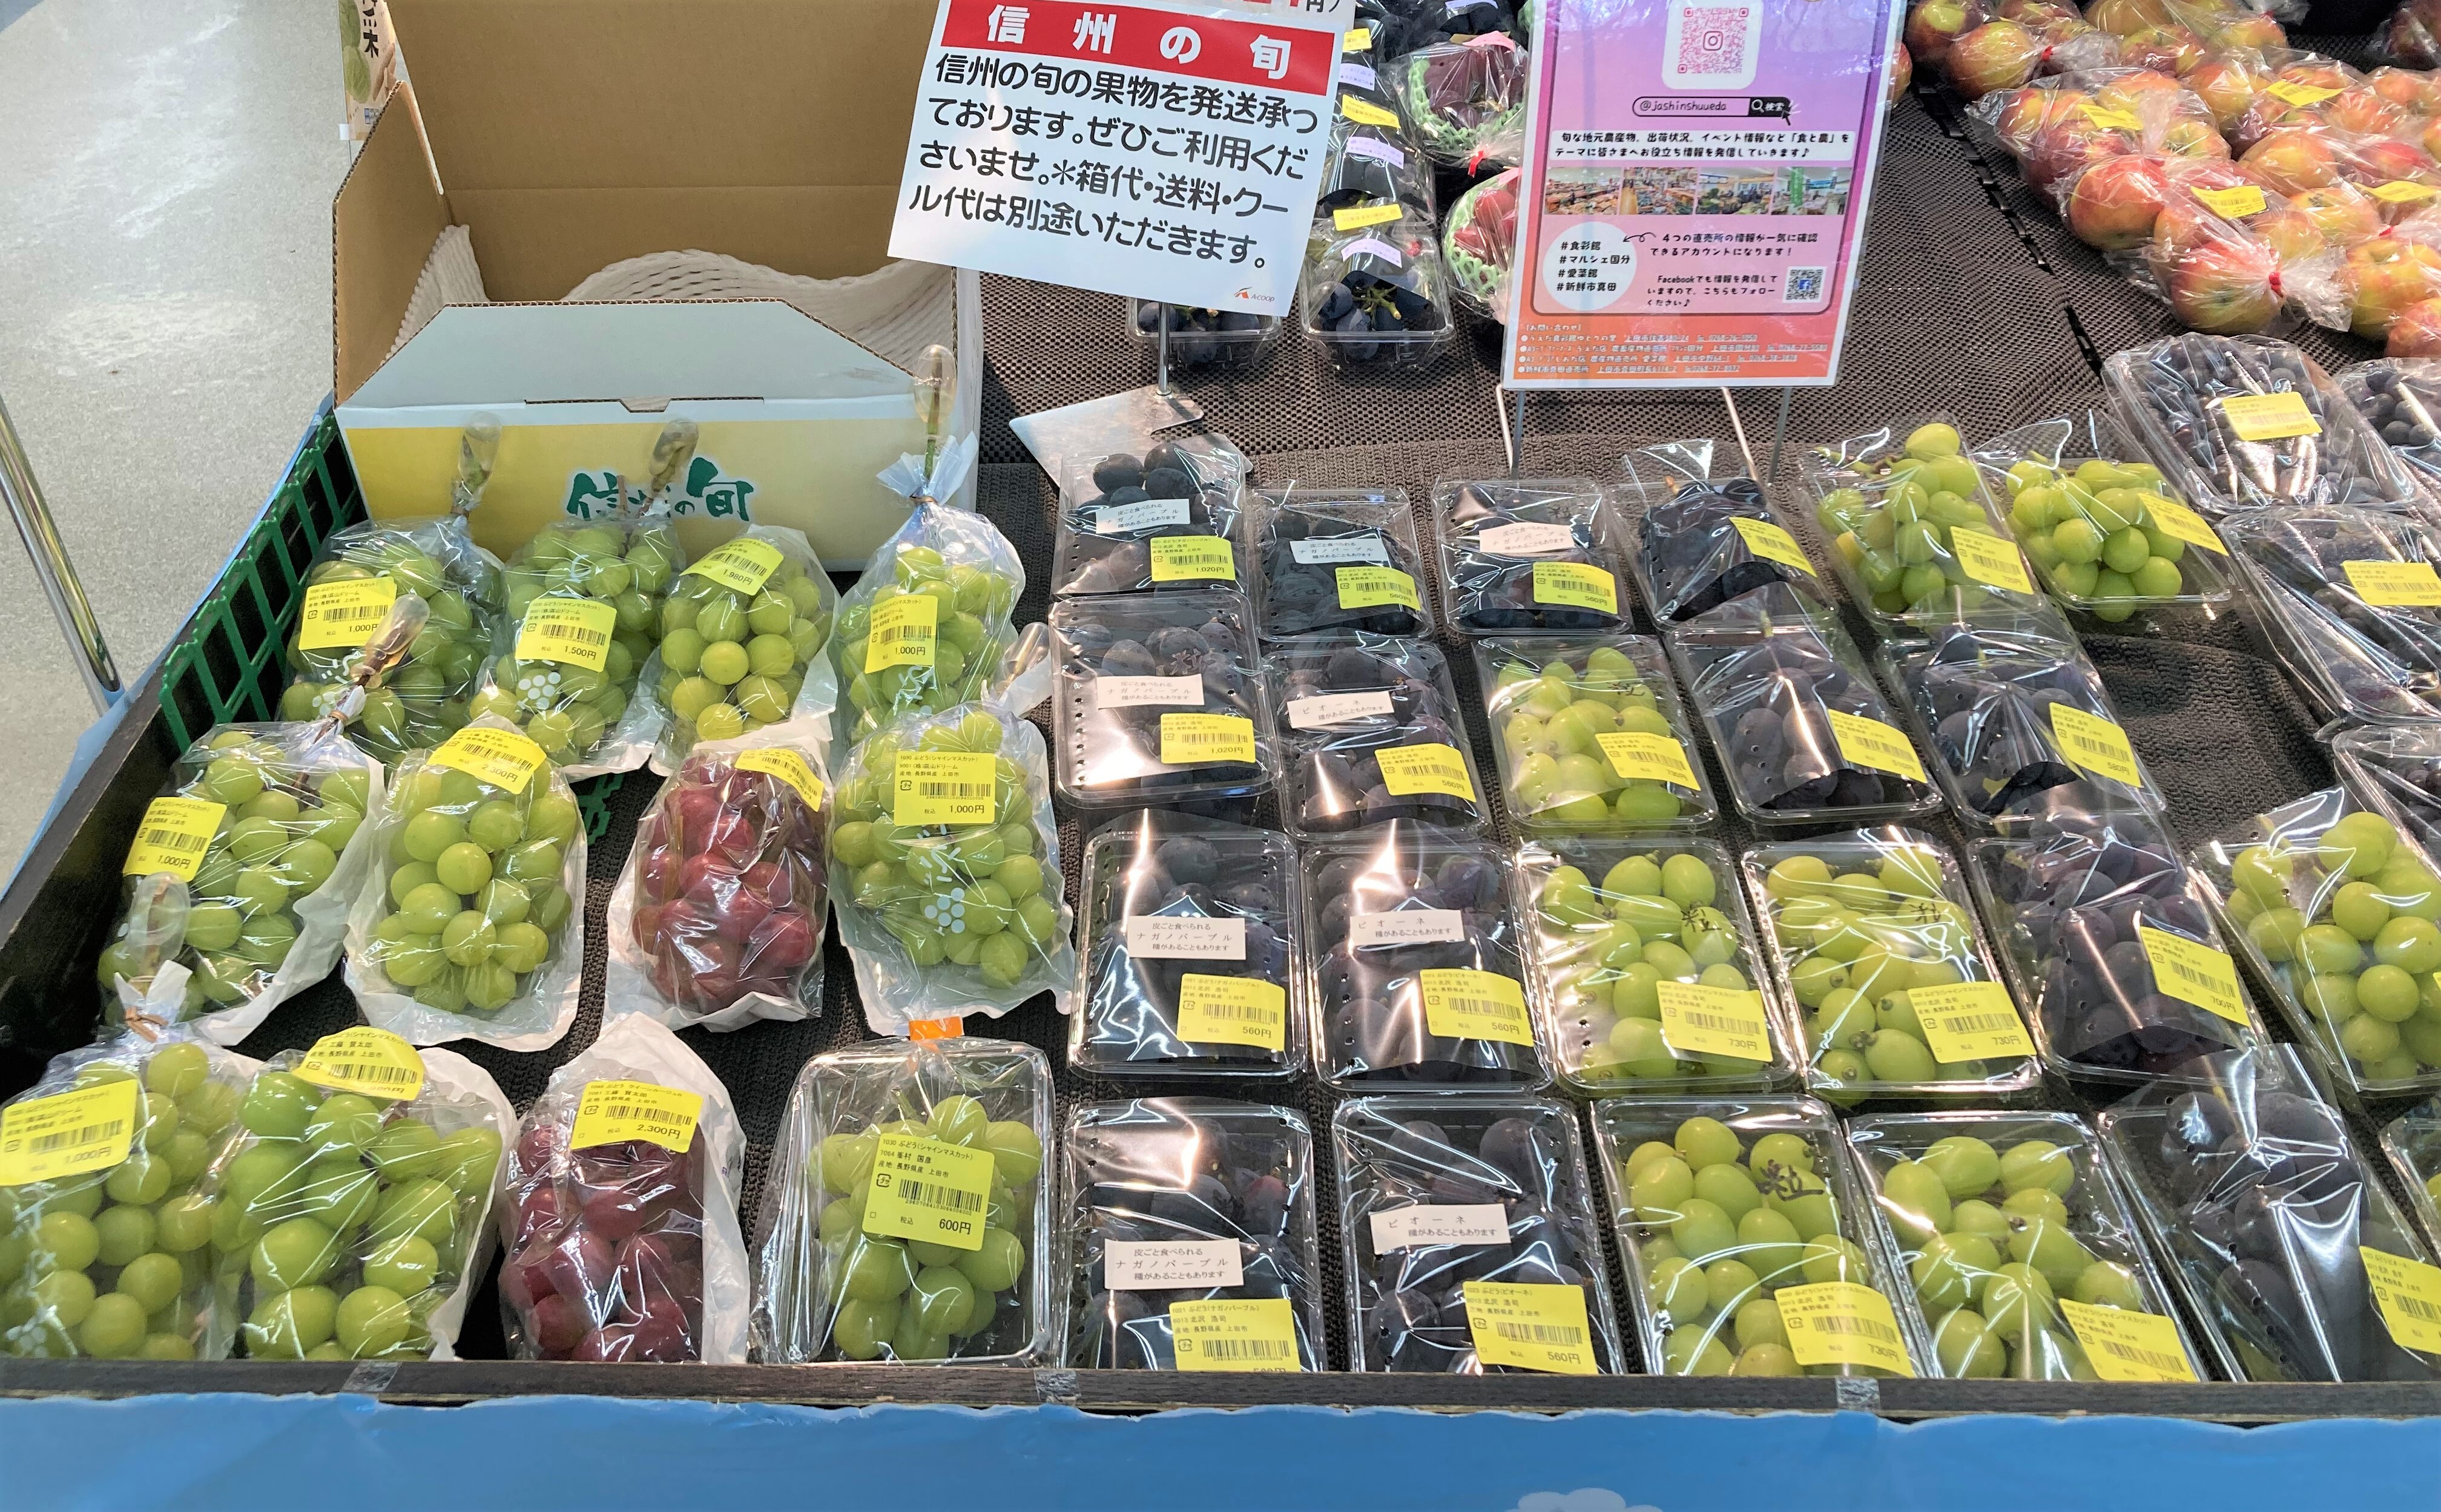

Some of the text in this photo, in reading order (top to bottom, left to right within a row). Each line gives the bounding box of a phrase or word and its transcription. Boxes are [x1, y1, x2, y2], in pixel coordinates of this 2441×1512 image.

[987, 4, 1293, 80] 信州の旬
[936, 53, 1318, 134] 信州の旬の果物を発送承つ
[928, 98, 1308, 179] ております。ぜひご利用くだ
[909, 184, 1265, 269] ル代は別途いただきます。
[1560, 255, 1630, 264] #マルシェ国分
[1557, 282, 1617, 291] #新鮮市真田
[723, 569, 753, 585] 1,980円
[564, 645, 596, 660] 1,500円
[895, 646, 925, 656] 1,000円
[481, 764, 518, 783] 2,300円
[1442, 780, 1464, 792] 560円
[950, 805, 984, 814] 1,000円
[157, 855, 191, 869] 1,000円
[1137, 933, 1232, 942] ナガノパープル
[1243, 1027, 1271, 1039] 560円
[1492, 1022, 1520, 1035] 560円
[1728, 1038, 1757, 1050] 730円
[1992, 1036, 2021, 1045] 730円
[637, 1125, 680, 1139] 2,300円
[899, 1140, 973, 1161] ぶどう(シャインマスカット)
[897, 1163, 923, 1173] 長野県産
[929, 1169, 949, 1178] 上田市
[900, 1216, 971, 1235] 税込 600円
[1388, 1215, 1465, 1229] ピオーネ
[1409, 1228, 1497, 1237] 種があることもあります
[1134, 1248, 1202, 1257] 皮ごと食べられる
[1116, 1258, 1228, 1269] ナガノパープル
[1134, 1271, 1225, 1280] 種があることもあります
[1548, 1351, 1581, 1364] 560円
